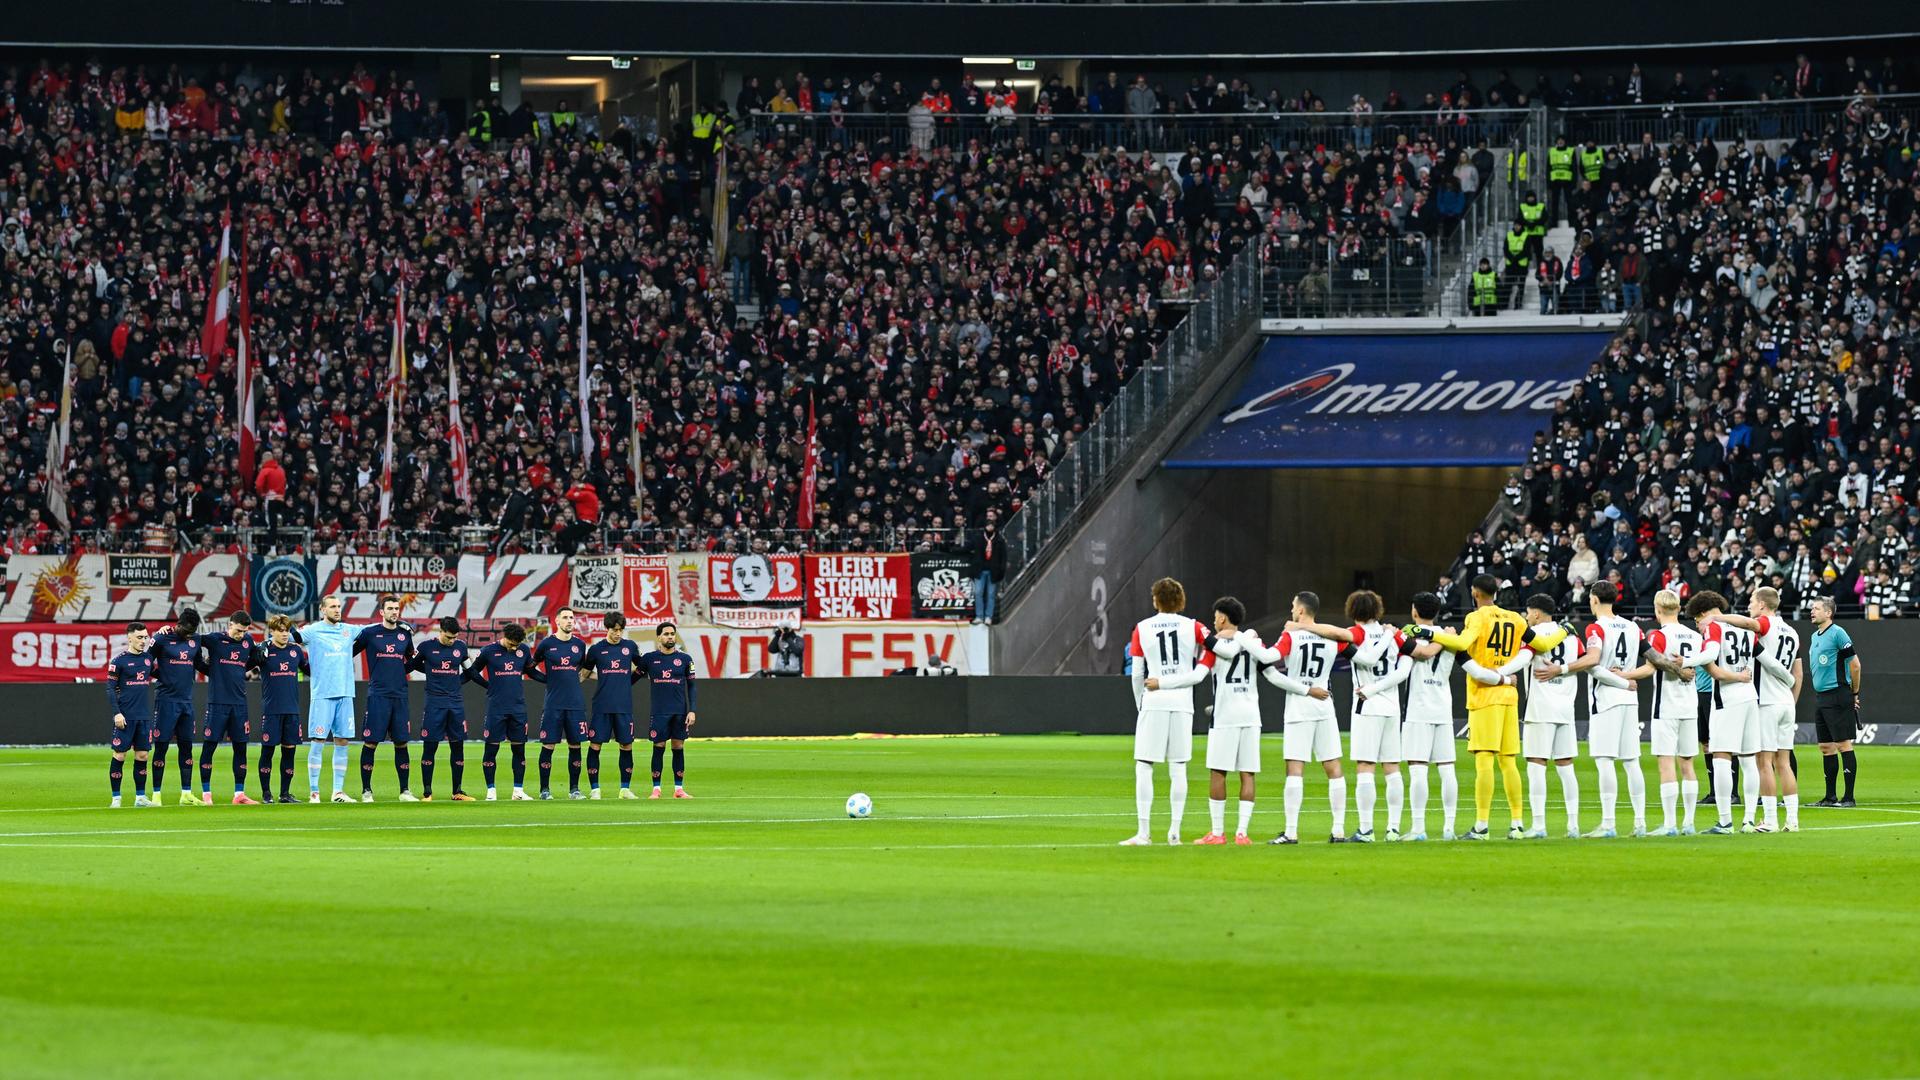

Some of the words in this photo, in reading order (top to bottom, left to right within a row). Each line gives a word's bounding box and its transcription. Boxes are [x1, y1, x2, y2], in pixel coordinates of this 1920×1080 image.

[1305, 369, 1585, 414] mainova
[112, 568, 168, 579] PARADISO
[121, 558, 158, 569] CURVA
[341, 556, 424, 576] SEKTION
[818, 557, 887, 577] BLEIBT
[343, 577, 439, 592] STADIONVERBOT
[814, 577, 898, 598] STRAMM
[573, 600, 618, 610] RAZZISMO
[819, 597, 861, 618] SEK.
[867, 597, 893, 618] SV
[922, 599, 975, 607] MAINZ
[1090, 576, 1108, 650] 3
[717, 611, 796, 620] SUBURBIA
[1156, 630, 1180, 666] 11
[1487, 621, 1515, 657] 40
[1615, 632, 1628, 665] 4
[1725, 631, 1751, 665] 34
[1299, 642, 1325, 678] 15
[1775, 635, 1796, 670] 13
